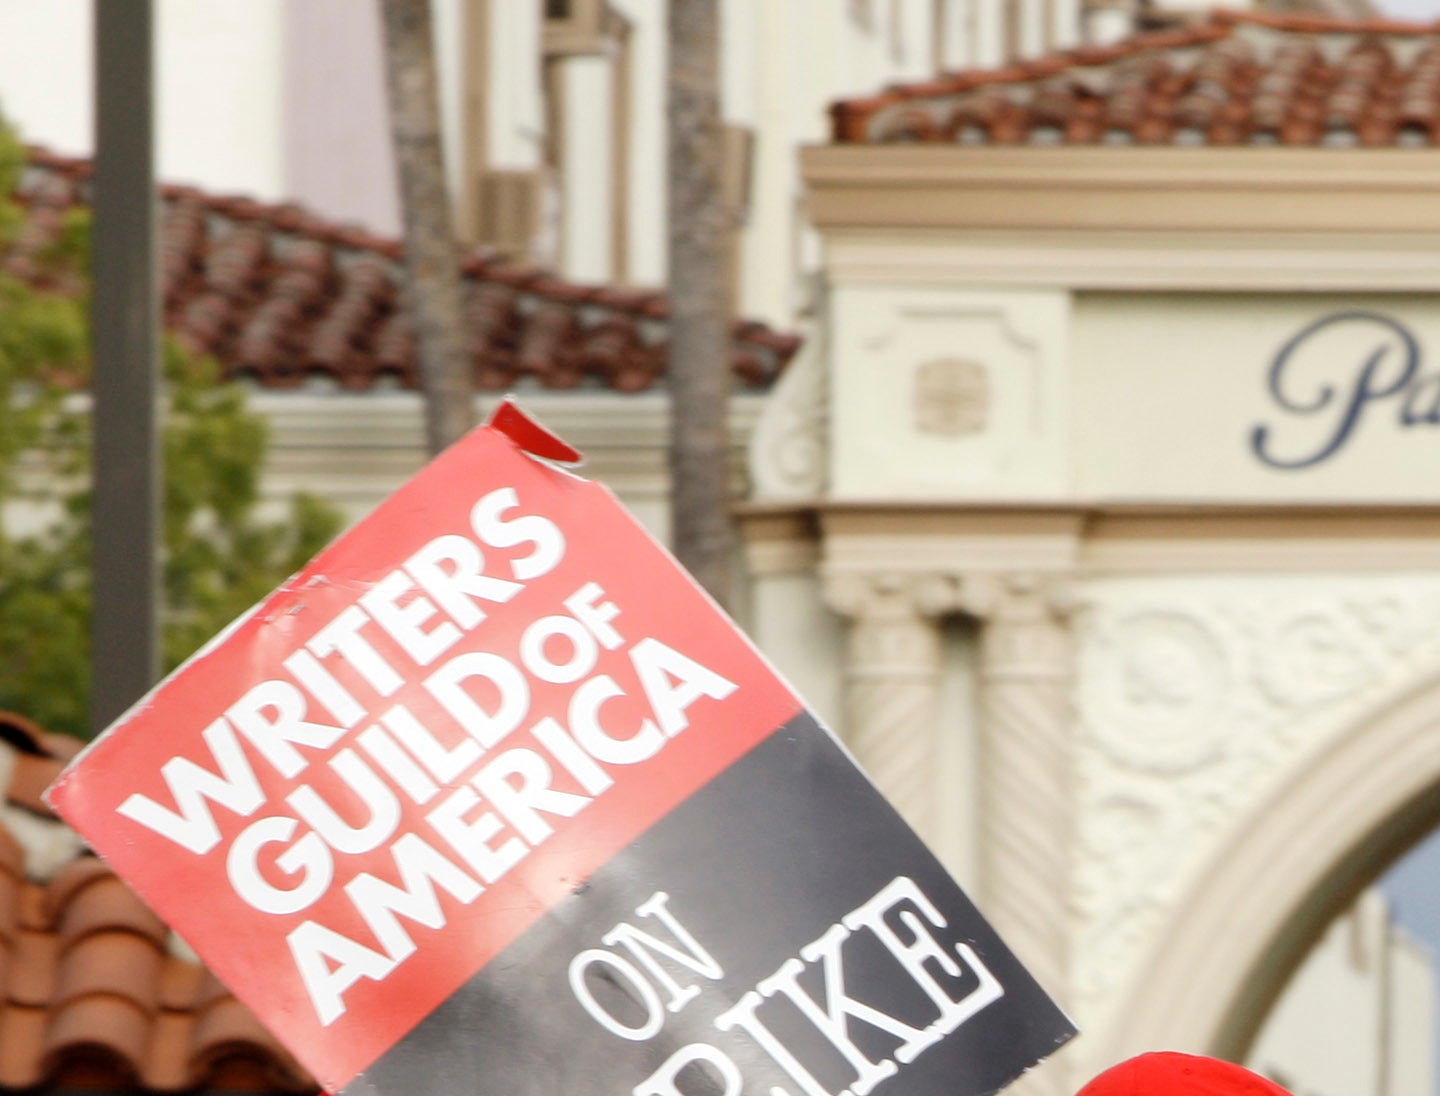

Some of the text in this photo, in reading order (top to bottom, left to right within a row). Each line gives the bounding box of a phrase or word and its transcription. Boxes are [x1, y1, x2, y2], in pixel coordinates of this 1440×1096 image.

[116, 487, 565, 855] WRITERS
[226, 582, 622, 915] GUILD OF
[285, 637, 737, 1027] AMERICA
[568, 891, 724, 1041] ON
